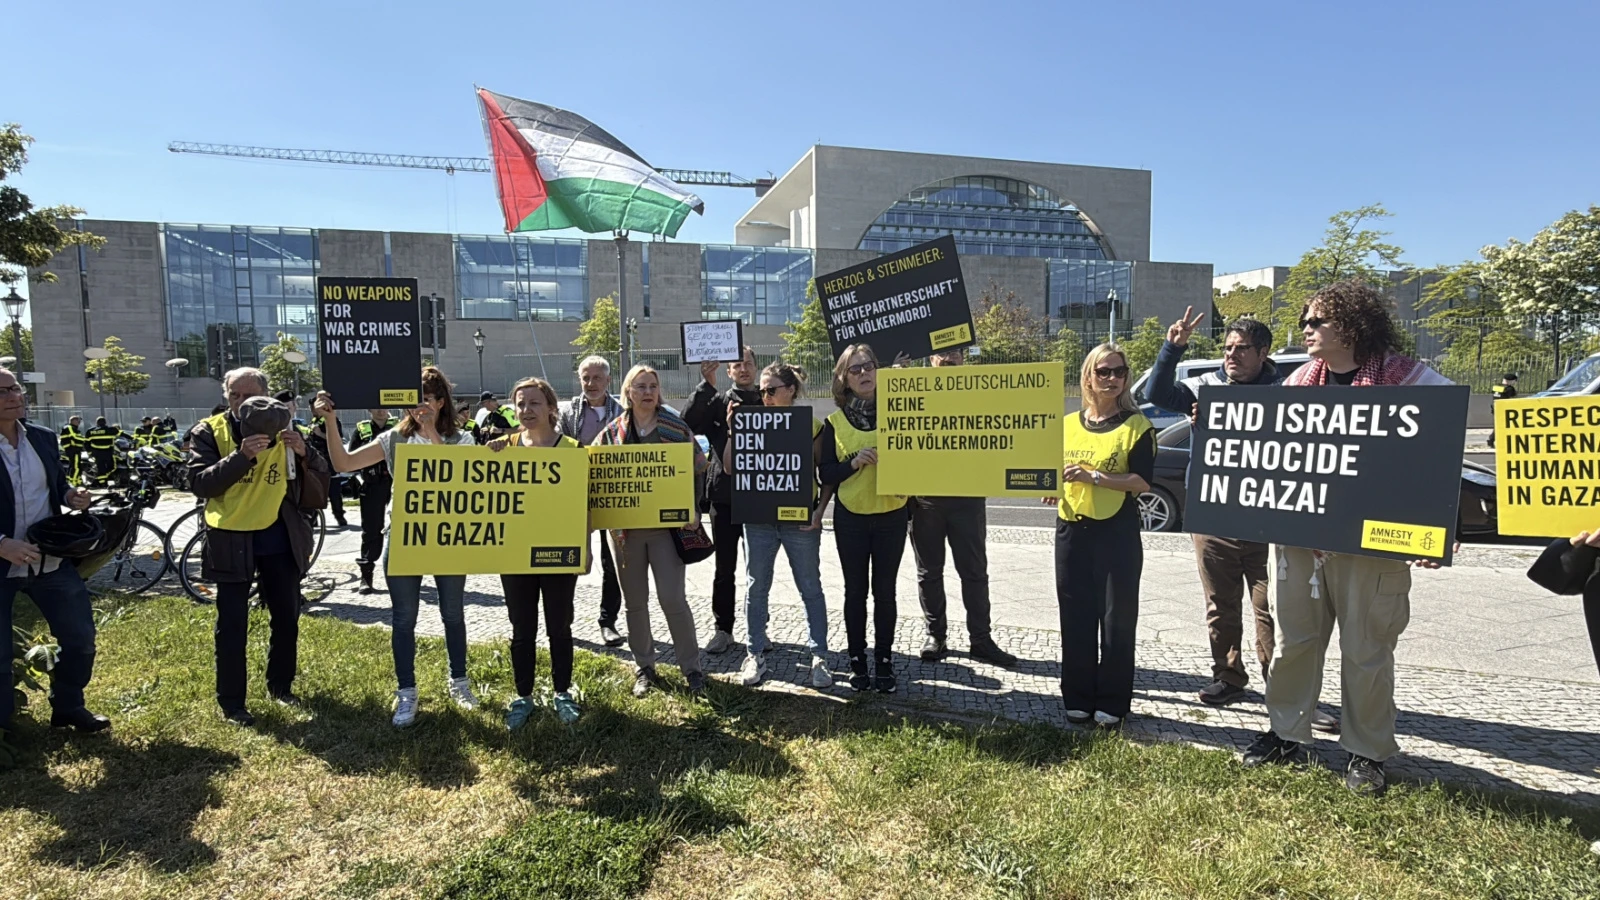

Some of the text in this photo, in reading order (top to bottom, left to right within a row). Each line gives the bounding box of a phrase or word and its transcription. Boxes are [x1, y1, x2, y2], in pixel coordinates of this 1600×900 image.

[824, 248, 944, 295] HERZOG & STEINMEIER:
[324, 286, 412, 300] NO WEAPONS
[827, 290, 858, 310] KEINE
[324, 304, 352, 318] FOR
[324, 322, 412, 336] WAR CRIMES
[835, 304, 932, 342] FÜR VÖLKERMORD!
[326, 340, 380, 354] IN GAZA
[887, 372, 1050, 392] ISRAEL & DEUTSCHLAND:
[887, 397, 925, 412] KEINE
[734, 412, 792, 430] STOPPT
[1208, 402, 1420, 438] END ISRAEL’S
[736, 433, 764, 450] DEN
[888, 433, 1013, 450] FÜR VÖLKERMORD!
[1506, 433, 1600, 454] INTERN
[588, 451, 666, 464] NTERNATIONALE
[736, 454, 801, 471] GENOZID
[1065, 450, 1096, 459] MNESTY
[1204, 438, 1360, 476] GENOCIDE
[406, 459, 561, 484] END ISRAEL’S
[590, 467, 632, 479] ERICHTE
[636, 466, 676, 478] ACHTEN
[590, 481, 652, 494] AFTBEFEHLE
[736, 474, 800, 492] IN GAZA!
[405, 490, 526, 514] GENOCIDE
[590, 496, 640, 508] MSETZEN!
[1200, 474, 1328, 514] IN GAZA!
[1508, 486, 1531, 505] IN
[403, 522, 505, 546] IN GAZA!
[1370, 528, 1413, 540] AMNESTY
[1370, 537, 1411, 546] INTERNATIONAL
